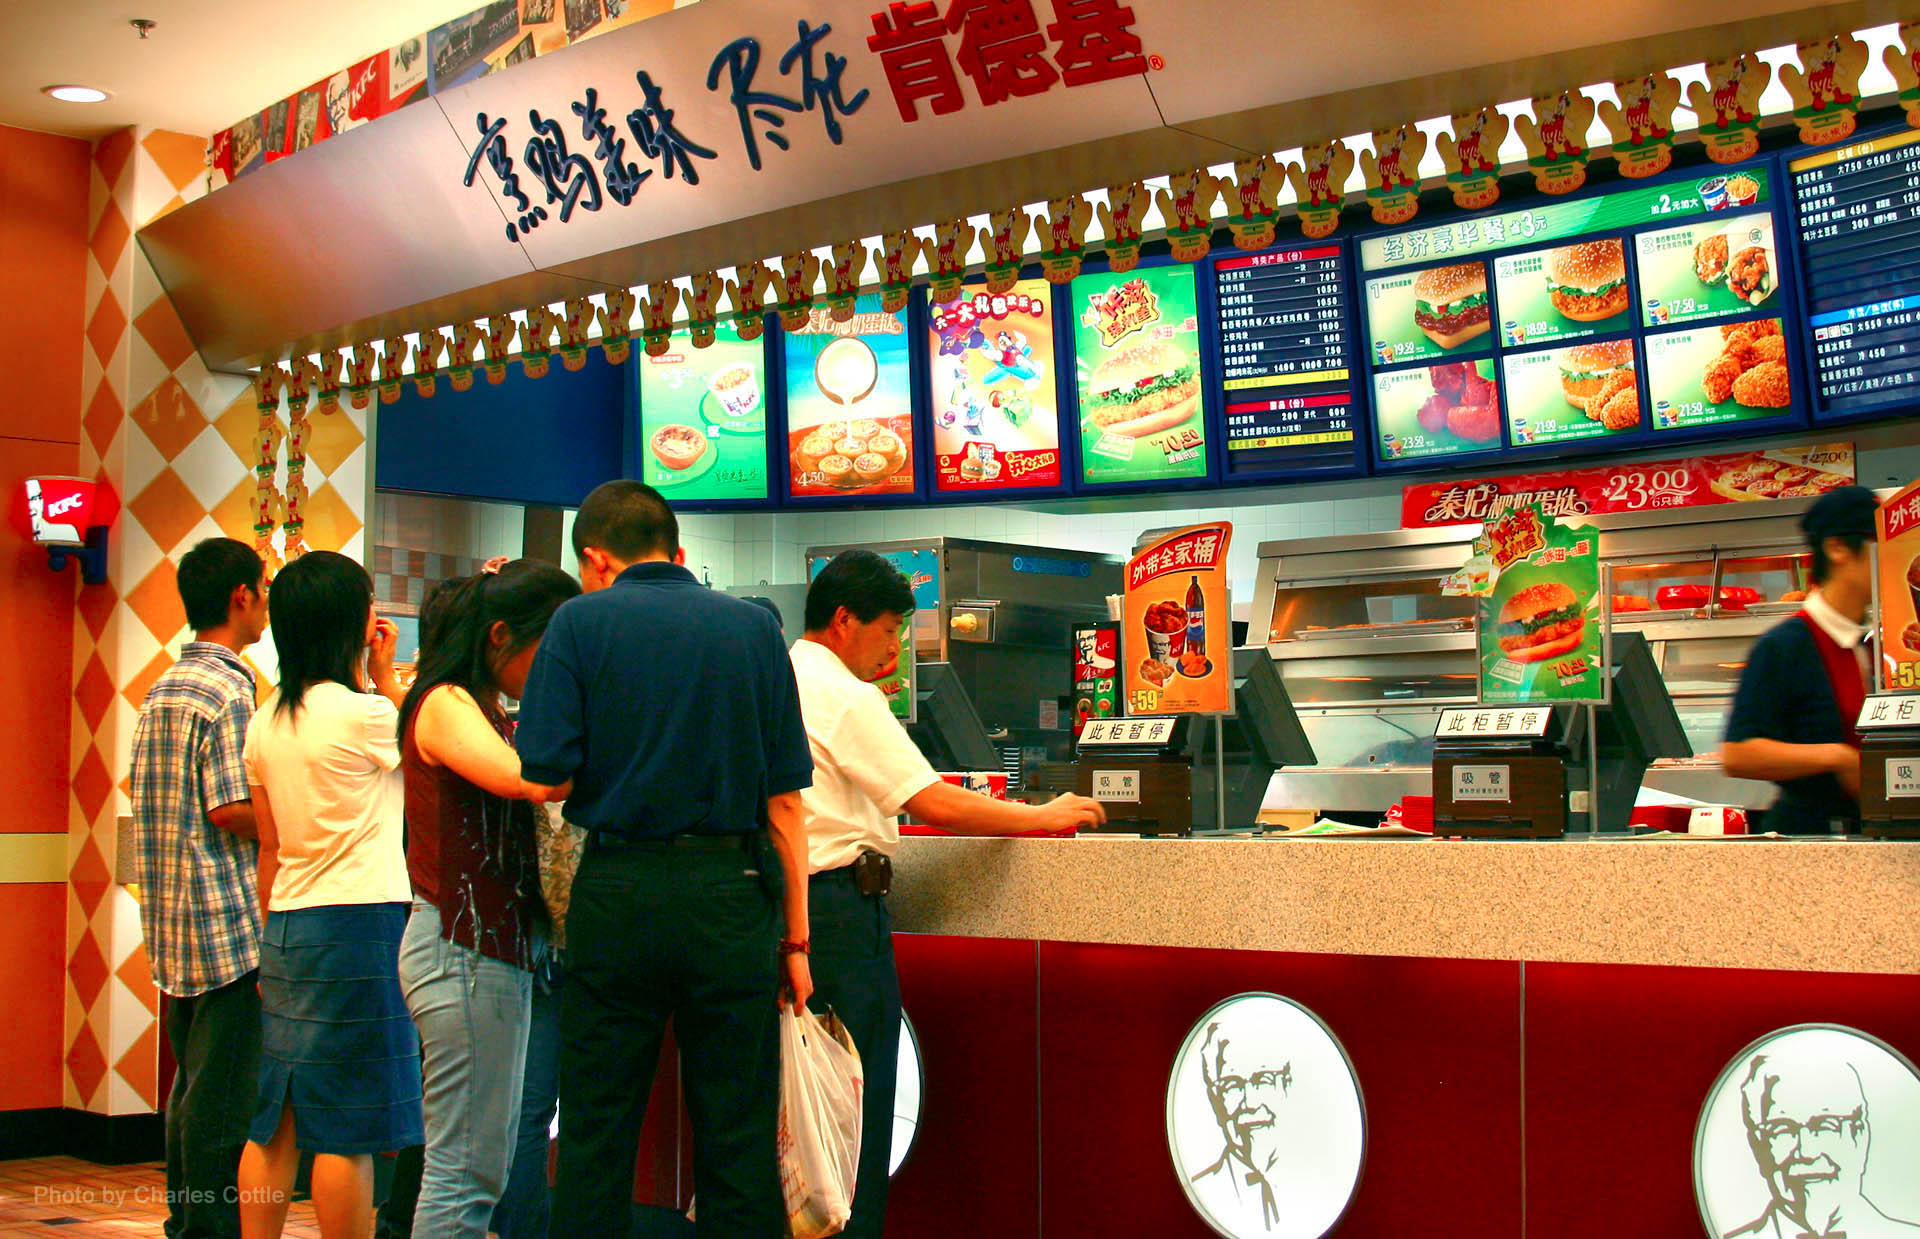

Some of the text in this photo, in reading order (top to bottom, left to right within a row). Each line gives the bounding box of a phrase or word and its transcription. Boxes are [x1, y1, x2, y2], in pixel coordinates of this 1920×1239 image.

[351, 56, 377, 109] KFC
[707, 19, 870, 171] 尽在
[867, 0, 1148, 123] 肯德基
[1383, 217, 1505, 260] 经济豪华餐
[48, 493, 83, 517] KFC
[1133, 535, 1219, 585] 外带全家桶
[1088, 722, 1166, 740] 此柜暂停
[1448, 712, 1538, 732] 此柜暂停
[1462, 772, 1501, 785] 吸管
